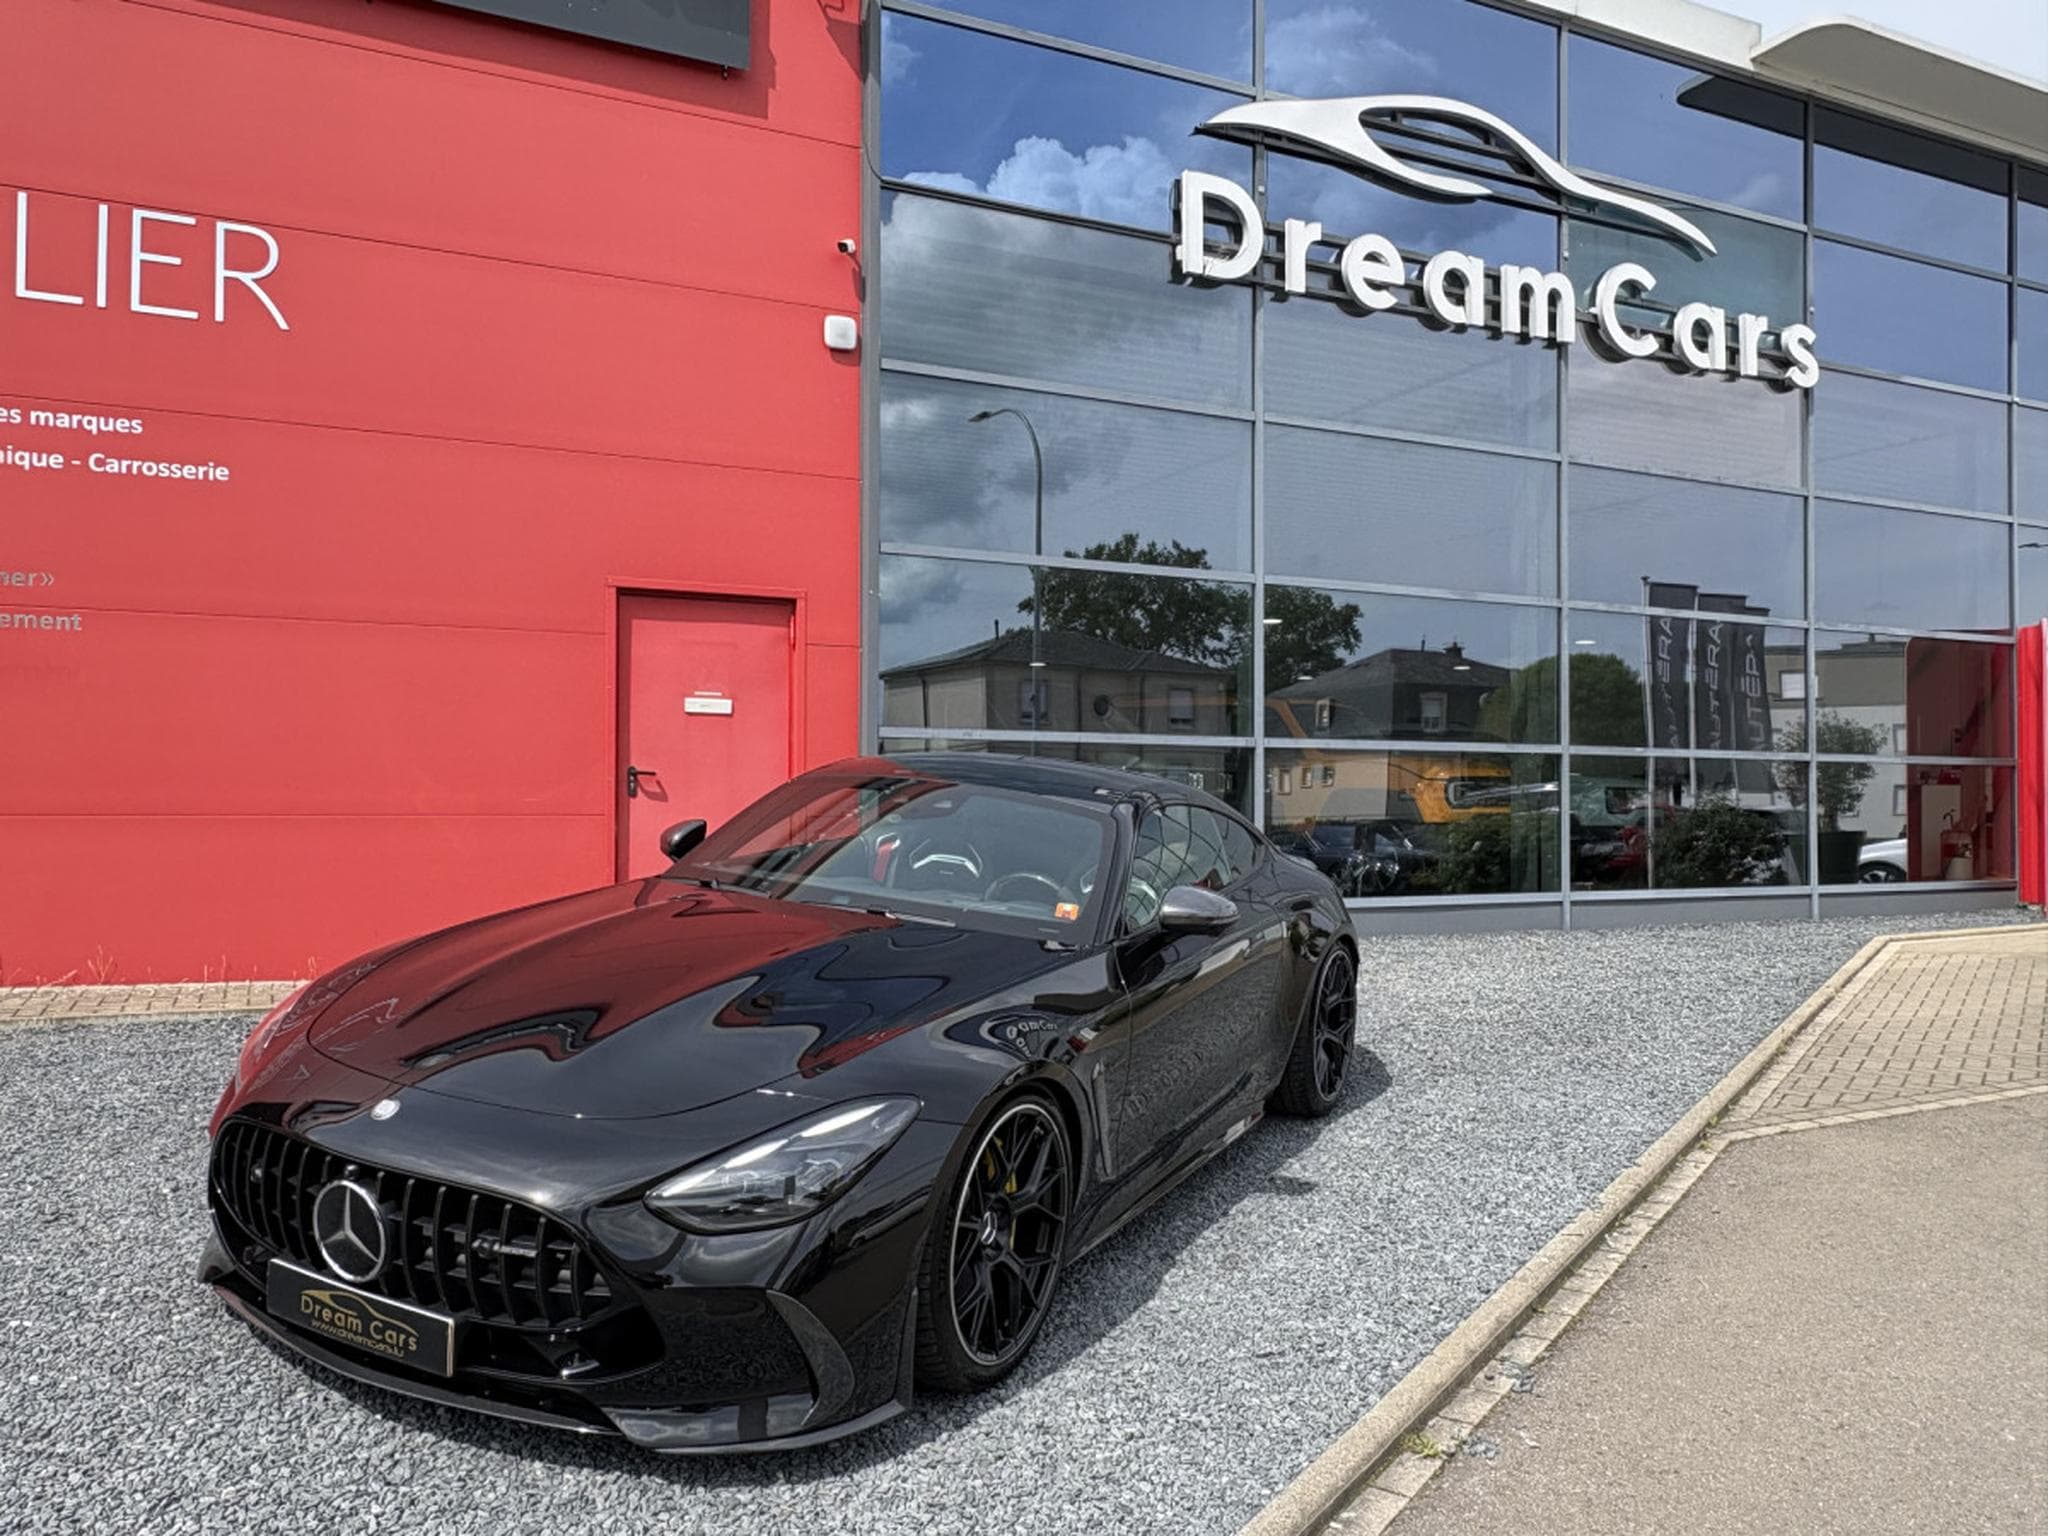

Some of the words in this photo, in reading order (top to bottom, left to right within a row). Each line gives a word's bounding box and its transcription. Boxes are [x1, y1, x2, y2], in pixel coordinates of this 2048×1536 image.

[16, 191, 290, 330] LIER
[30, 410, 143, 434] marques
[88, 453, 230, 481] Carrosserie
[301, 1295, 362, 1334] Dream
[369, 1320, 418, 1352] Cars
